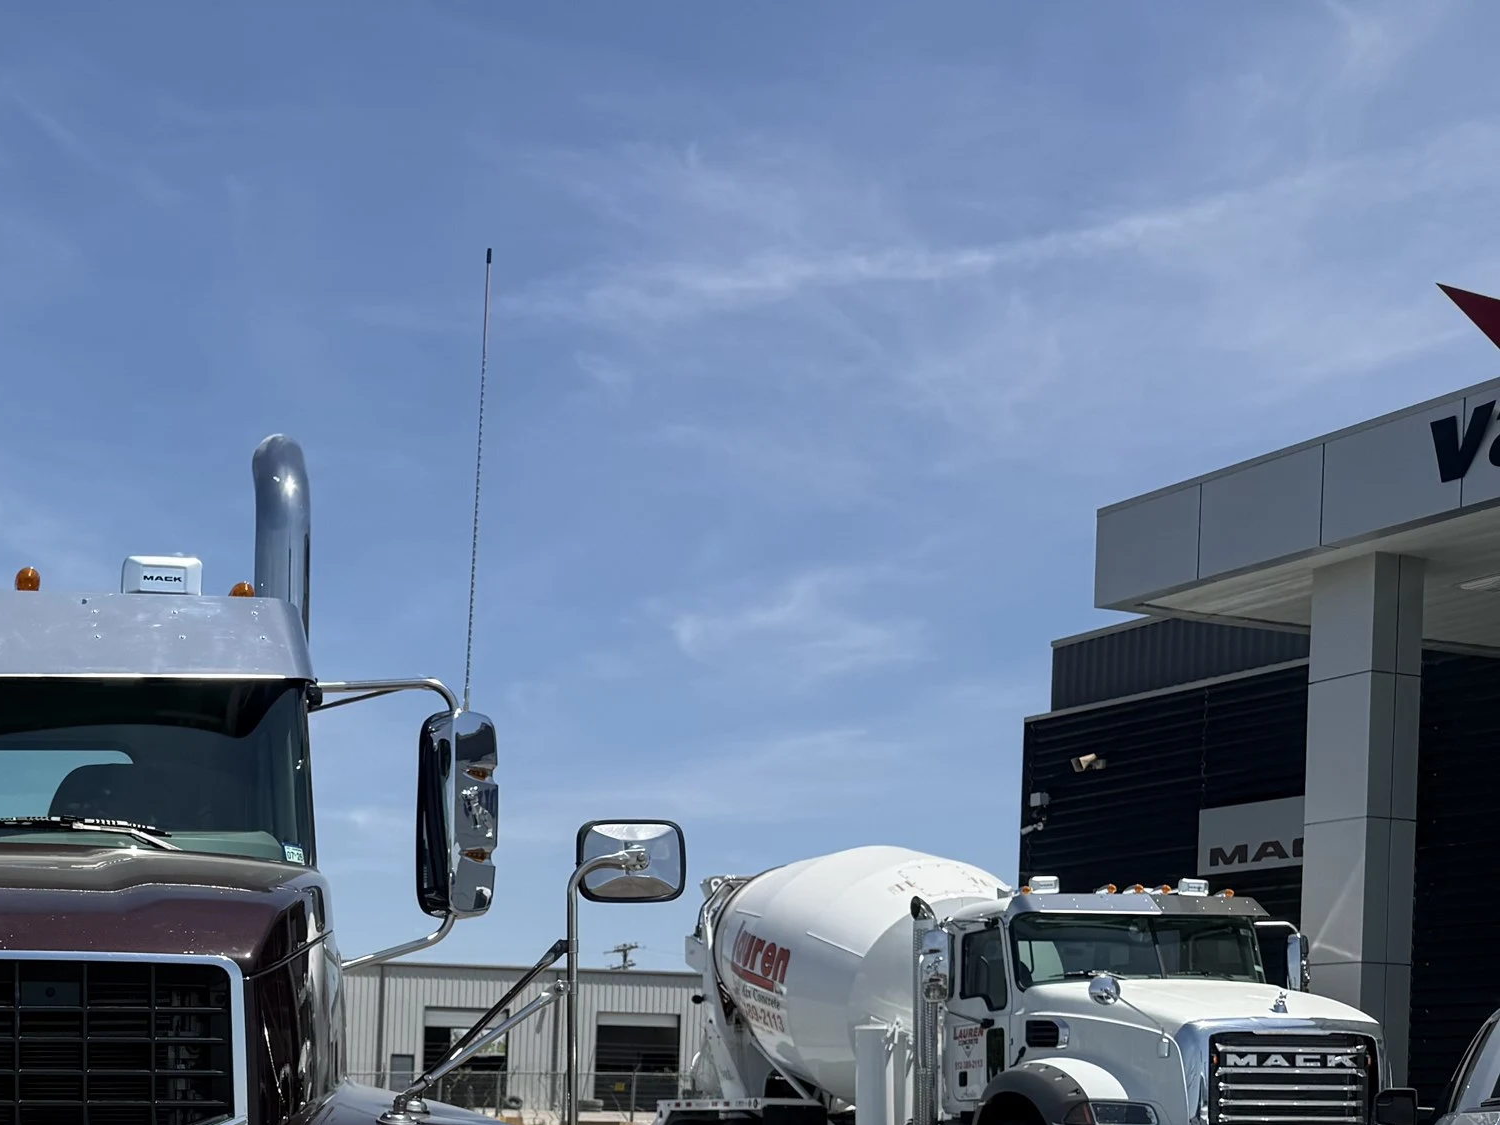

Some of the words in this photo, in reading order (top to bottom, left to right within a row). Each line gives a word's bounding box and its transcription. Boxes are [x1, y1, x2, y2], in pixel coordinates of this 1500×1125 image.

[1430, 400, 1500, 482] V
[953, 1026, 984, 1040] LAUREN
[1226, 1053, 1359, 1067] MACK
